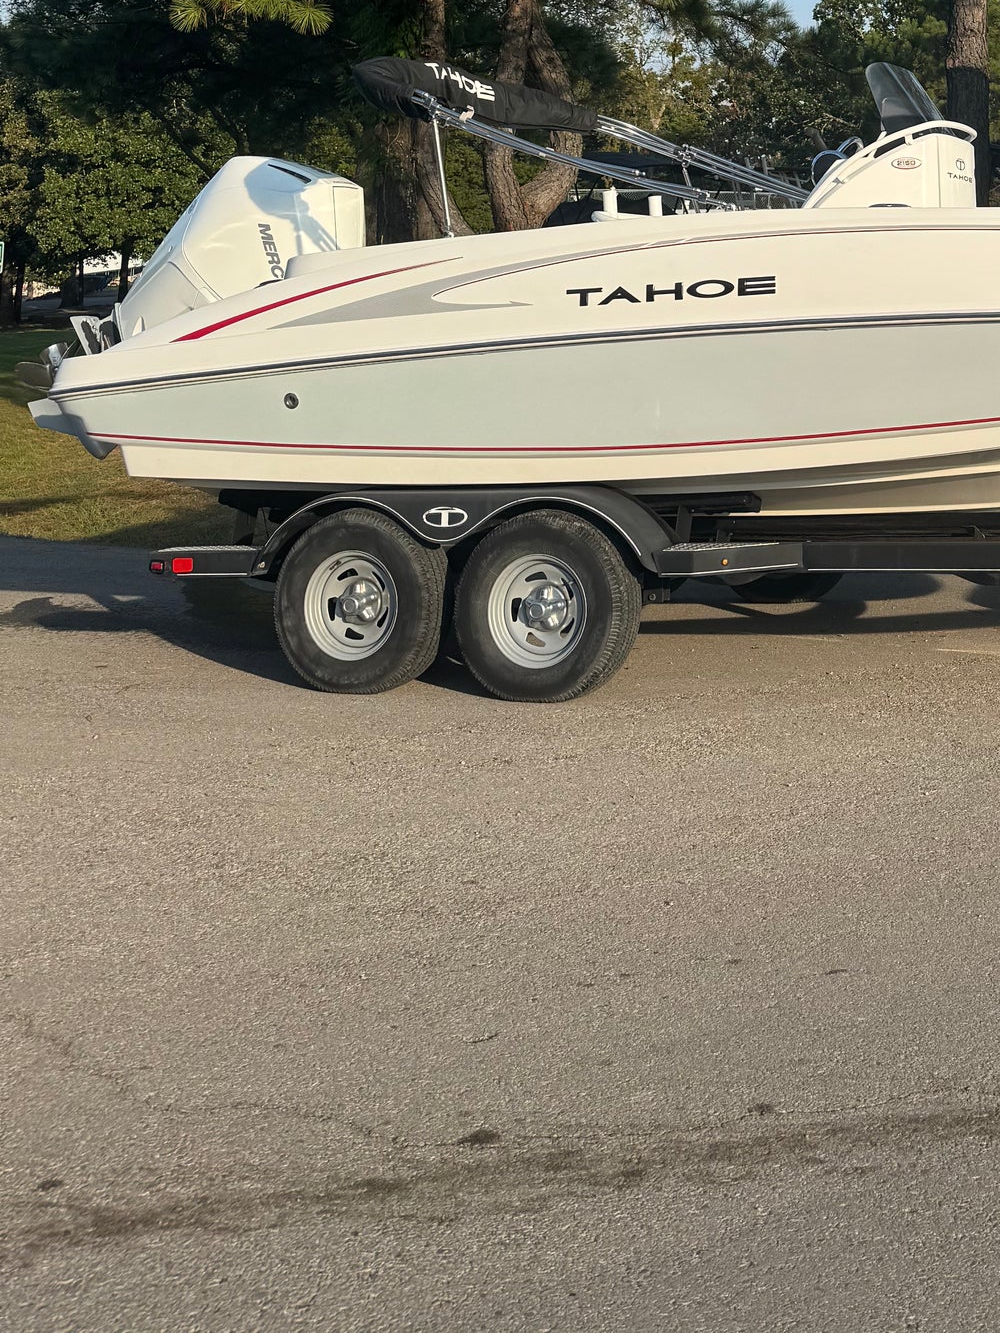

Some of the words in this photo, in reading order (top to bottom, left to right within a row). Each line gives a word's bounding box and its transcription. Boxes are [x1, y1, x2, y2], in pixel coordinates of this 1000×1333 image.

[424, 62, 496, 101] TAHOE
[947, 172, 973, 183] TAHOE
[257, 223, 285, 279] MERC
[566, 276, 777, 307] TAHOE
